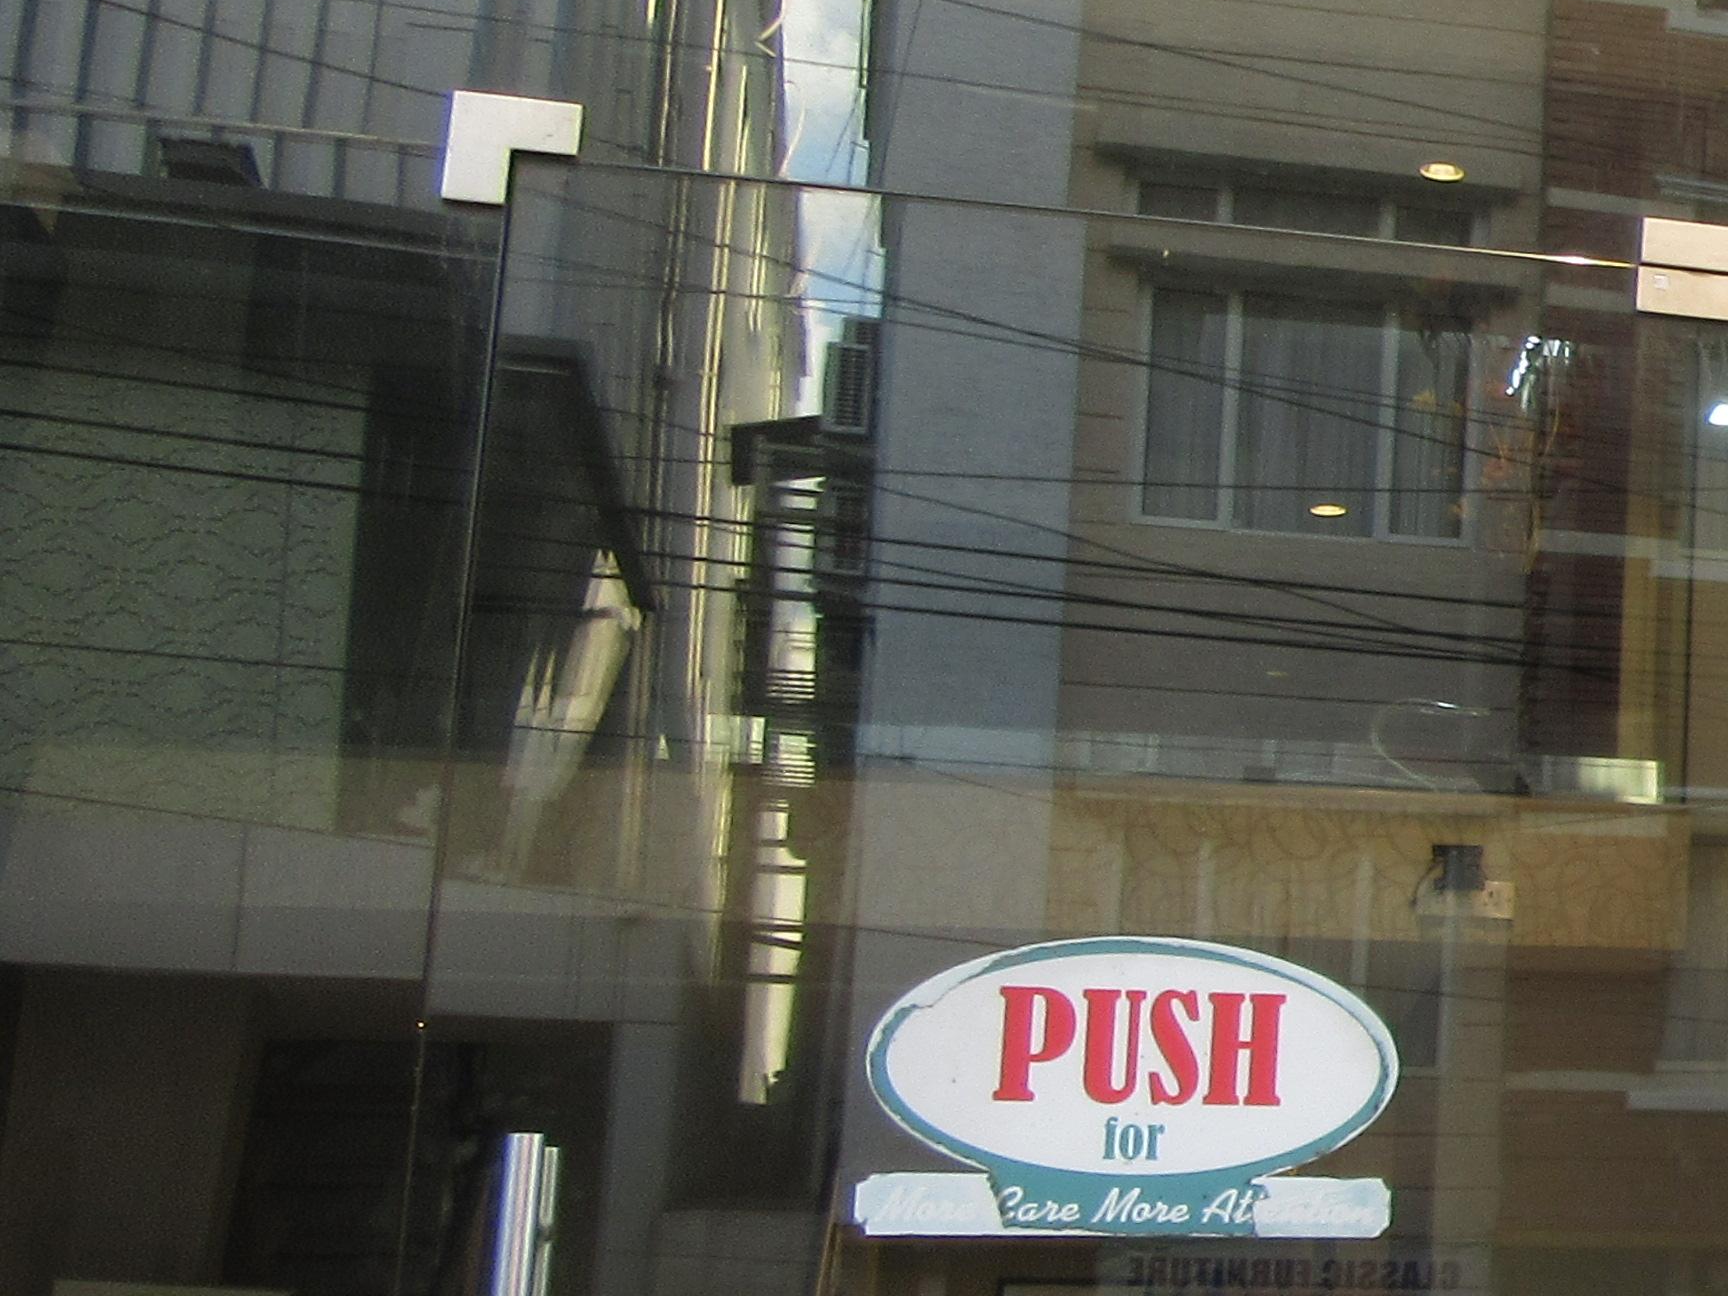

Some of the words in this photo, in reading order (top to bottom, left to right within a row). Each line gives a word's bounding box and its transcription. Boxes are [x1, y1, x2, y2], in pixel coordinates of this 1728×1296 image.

[992, 985, 1287, 1106] PUSH
[1102, 1117, 1165, 1160] for
[1000, 1187, 1080, 1223] Care
[1092, 1188, 1189, 1224] More
